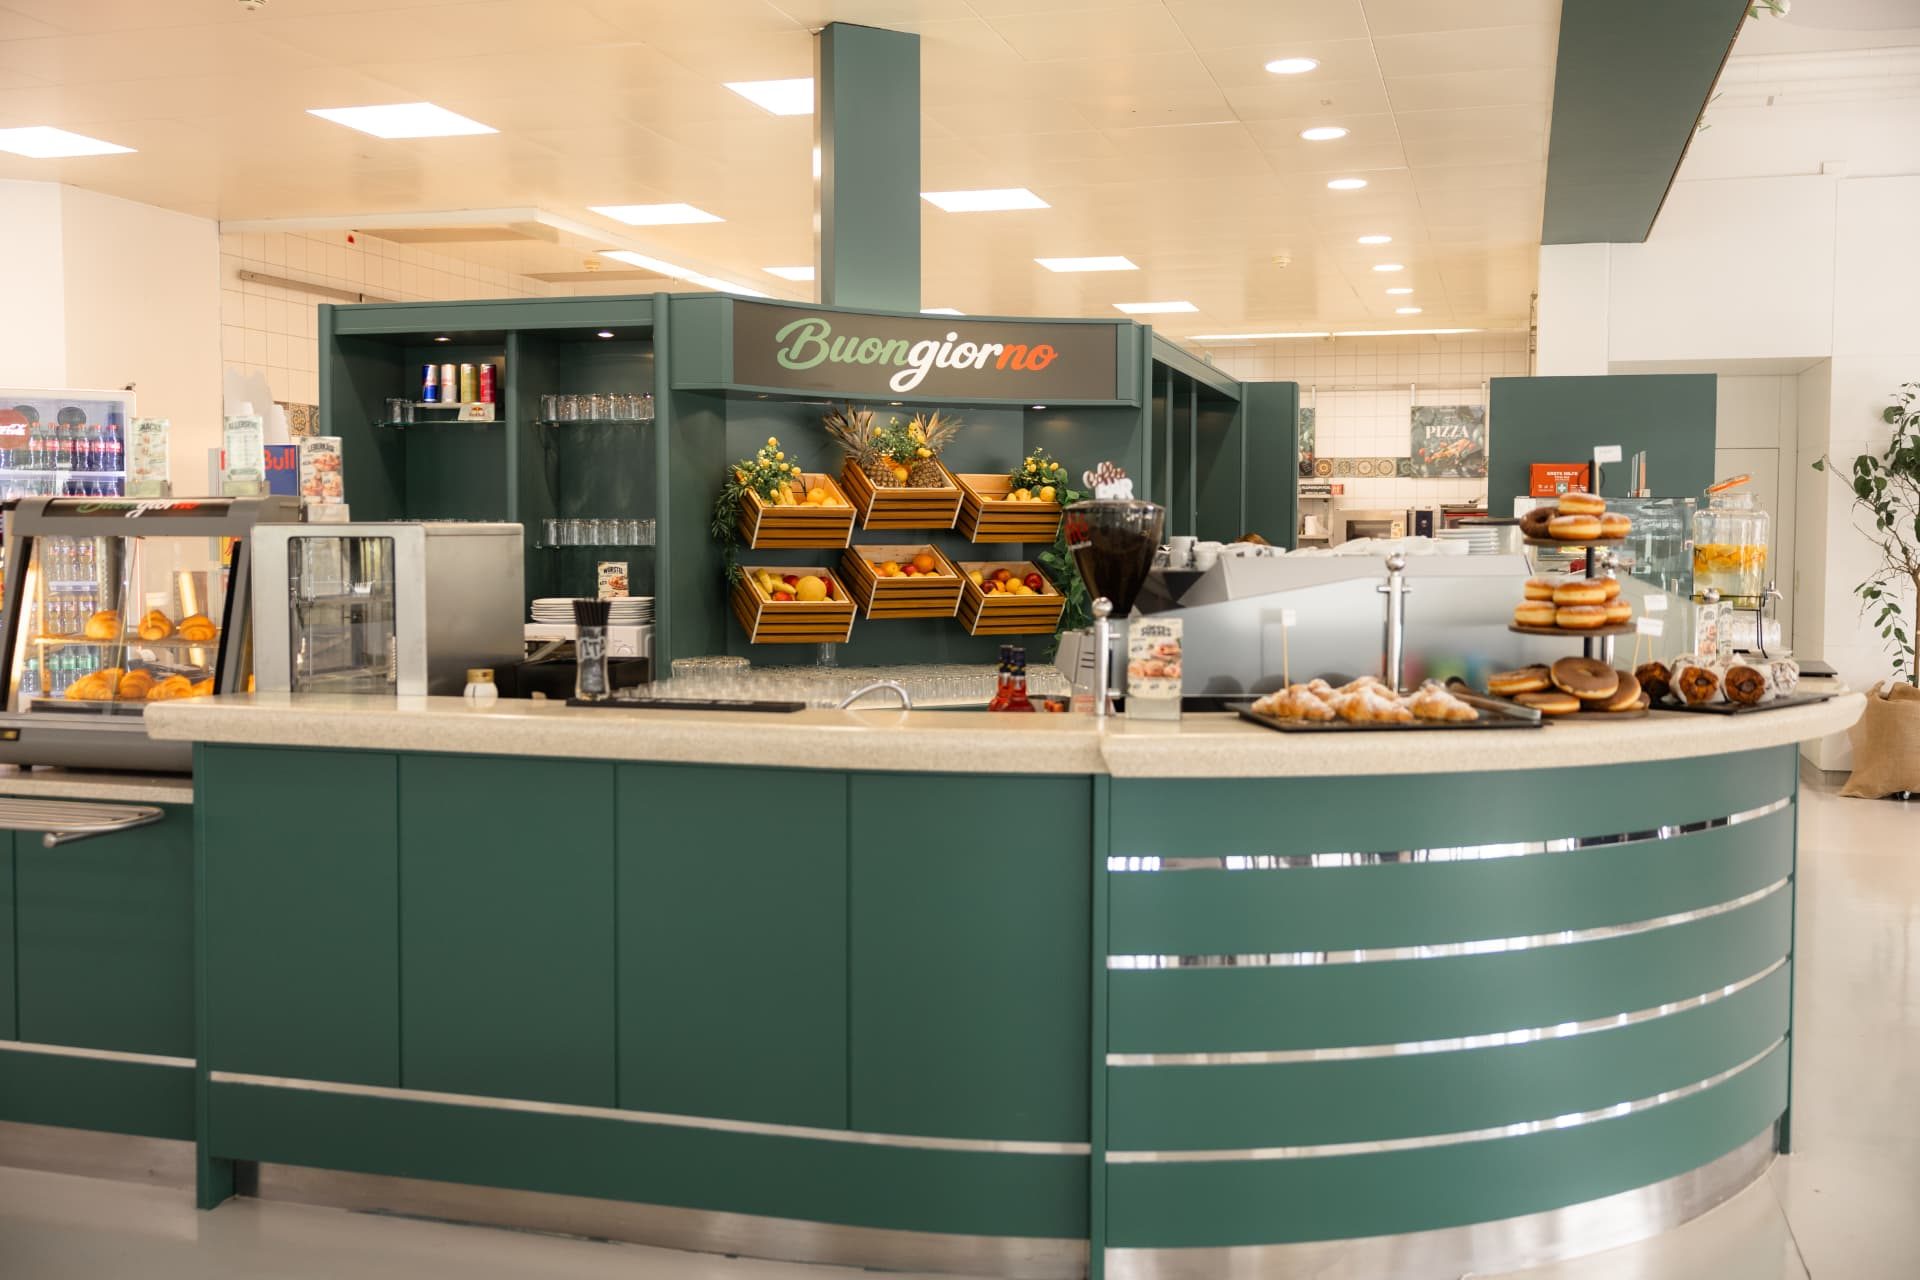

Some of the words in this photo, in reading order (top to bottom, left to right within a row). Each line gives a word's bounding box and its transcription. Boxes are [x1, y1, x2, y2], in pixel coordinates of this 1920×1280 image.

[775, 317, 1059, 393] Buongiorno
[1425, 425, 1470, 440] PIZZA
[264, 447, 295, 471] Bull
